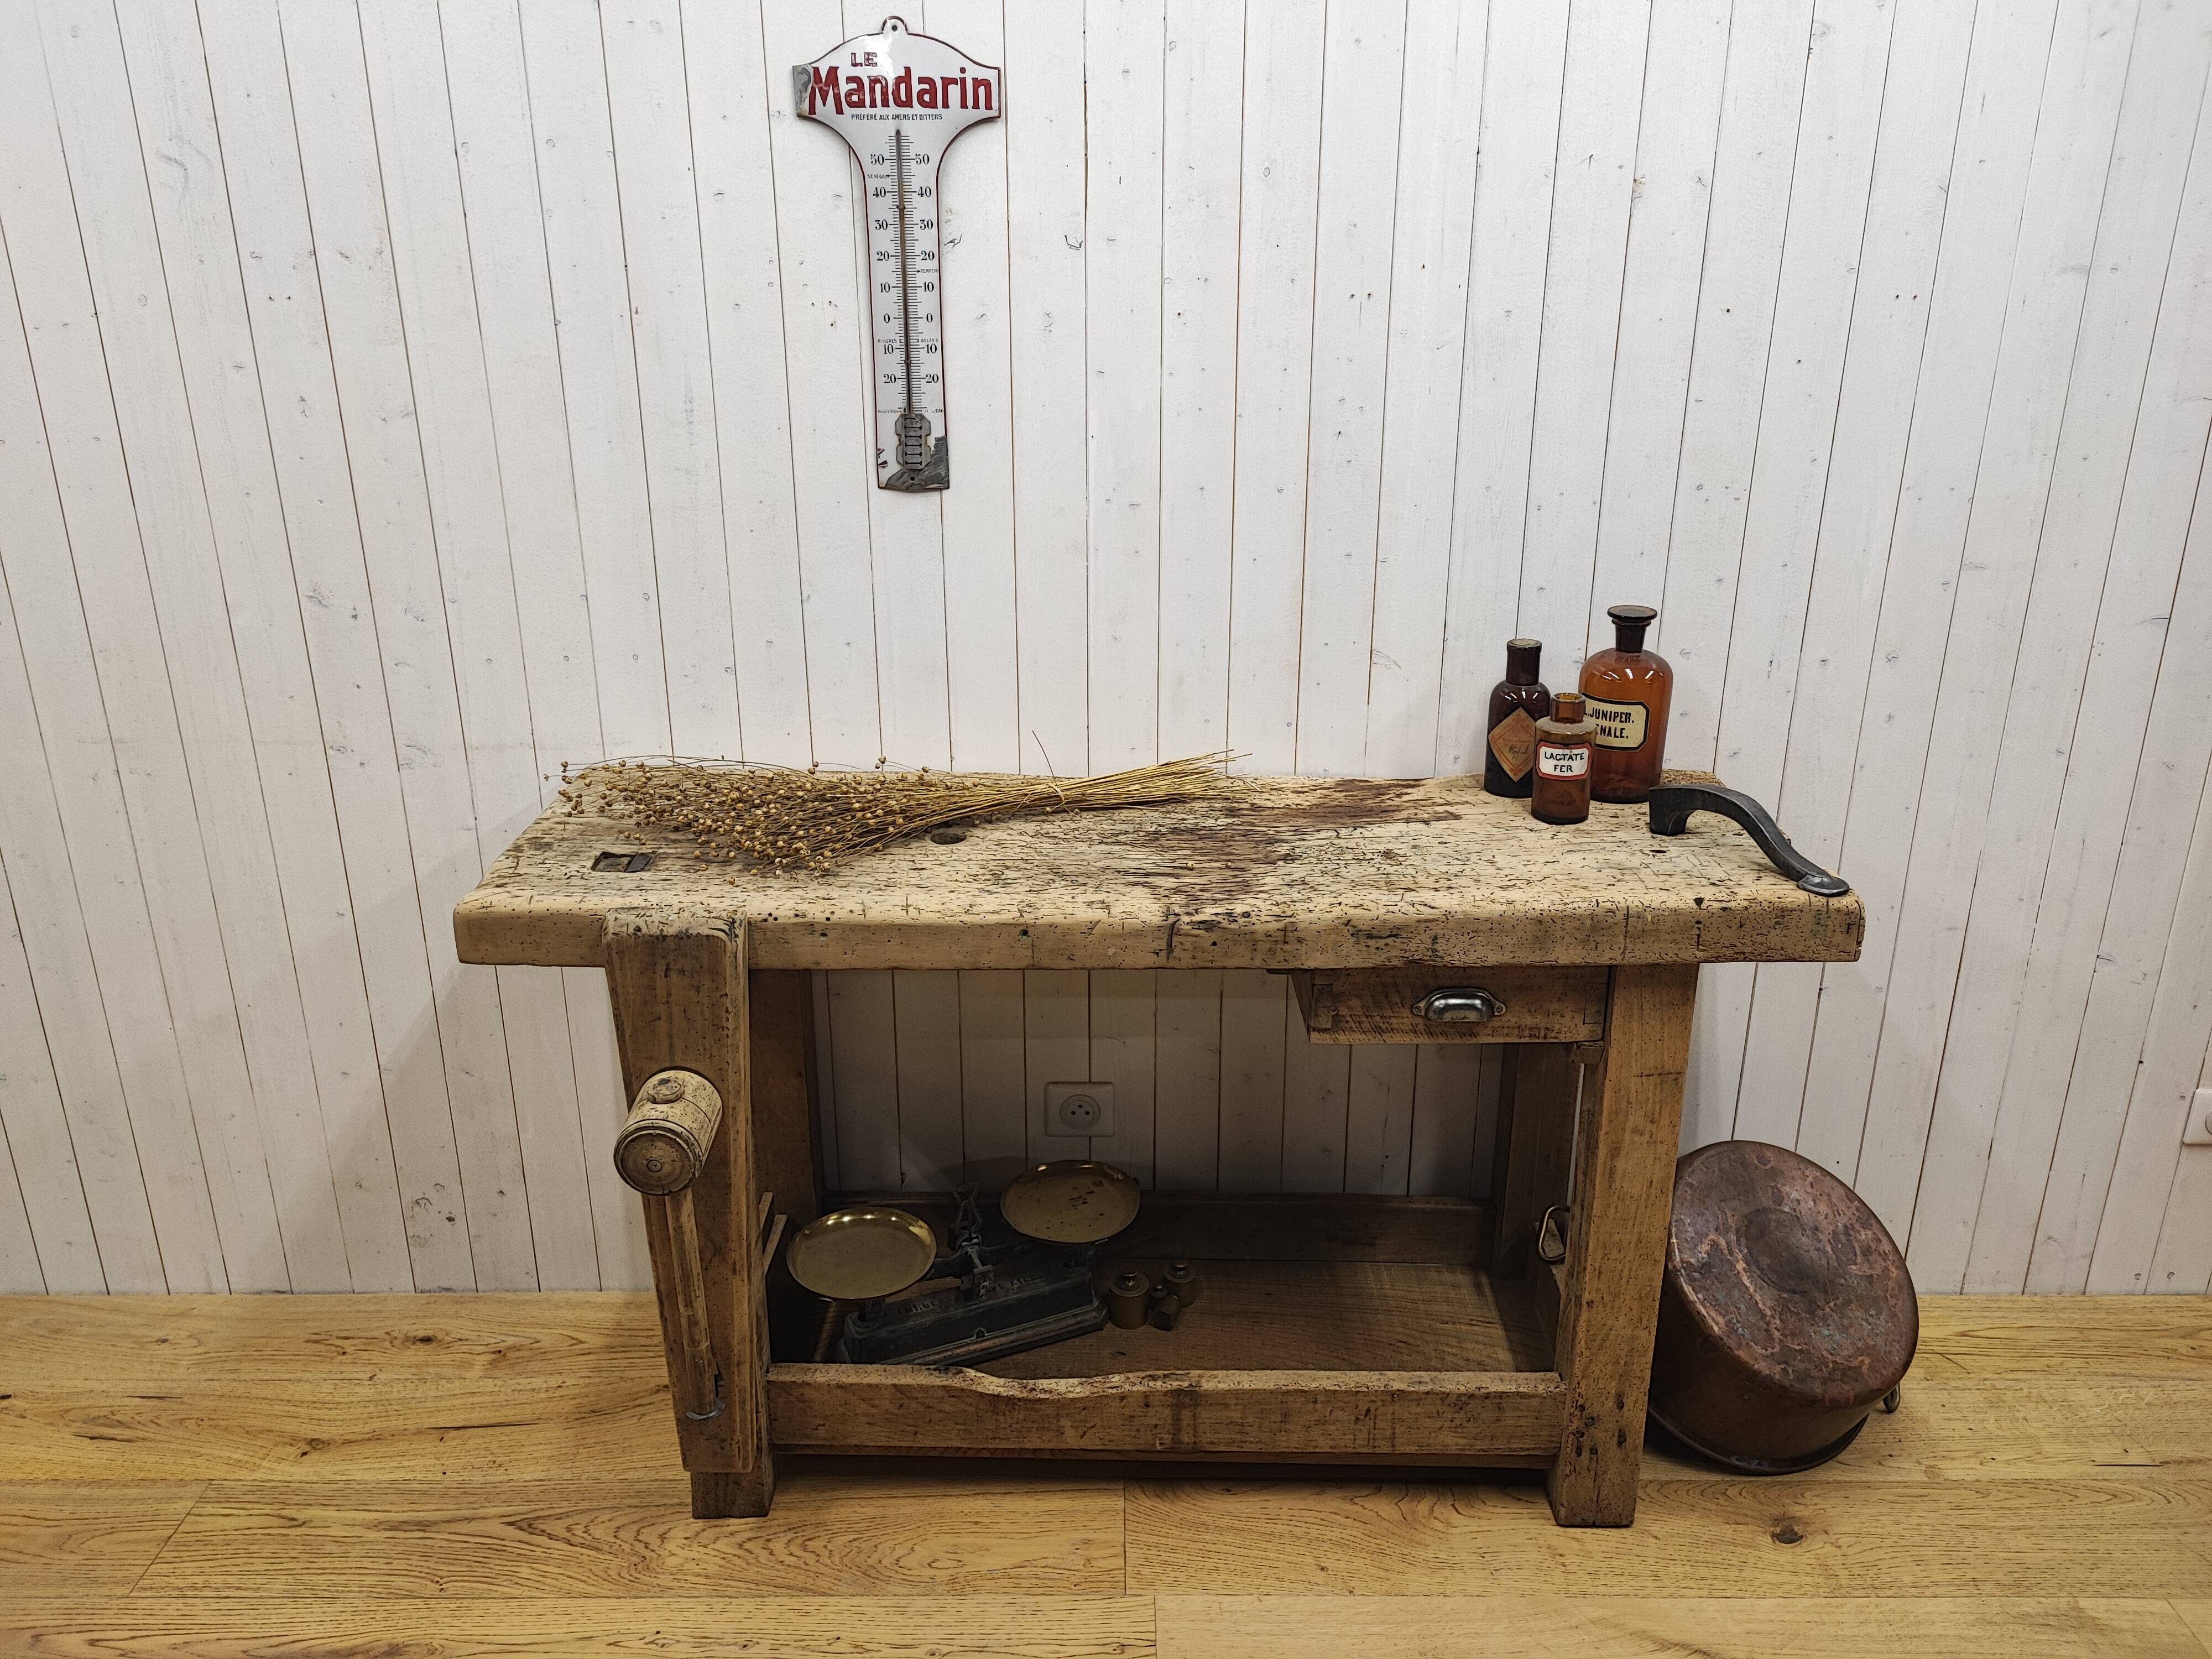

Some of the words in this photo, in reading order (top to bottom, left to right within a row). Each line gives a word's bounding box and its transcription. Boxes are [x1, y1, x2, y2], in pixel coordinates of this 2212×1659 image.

[851, 52, 878, 67] LE
[808, 66, 993, 116] Mandarin
[870, 154, 884, 165] 50
[915, 153, 930, 165] 50
[873, 186, 886, 197] 40
[917, 186, 932, 197] 40
[875, 219, 888, 230] 30
[920, 219, 933, 230] 30
[876, 251, 890, 261] 20
[920, 251, 935, 260] 20
[880, 282, 890, 293] 10
[924, 281, 934, 292] 10
[883, 313, 890, 324] 0
[926, 312, 933, 323] 0
[884, 343, 894, 354] 10
[926, 343, 937, 353] 10
[883, 374, 896, 384] 20
[925, 373, 939, 383] 20
[1554, 764, 1573, 773] FER
